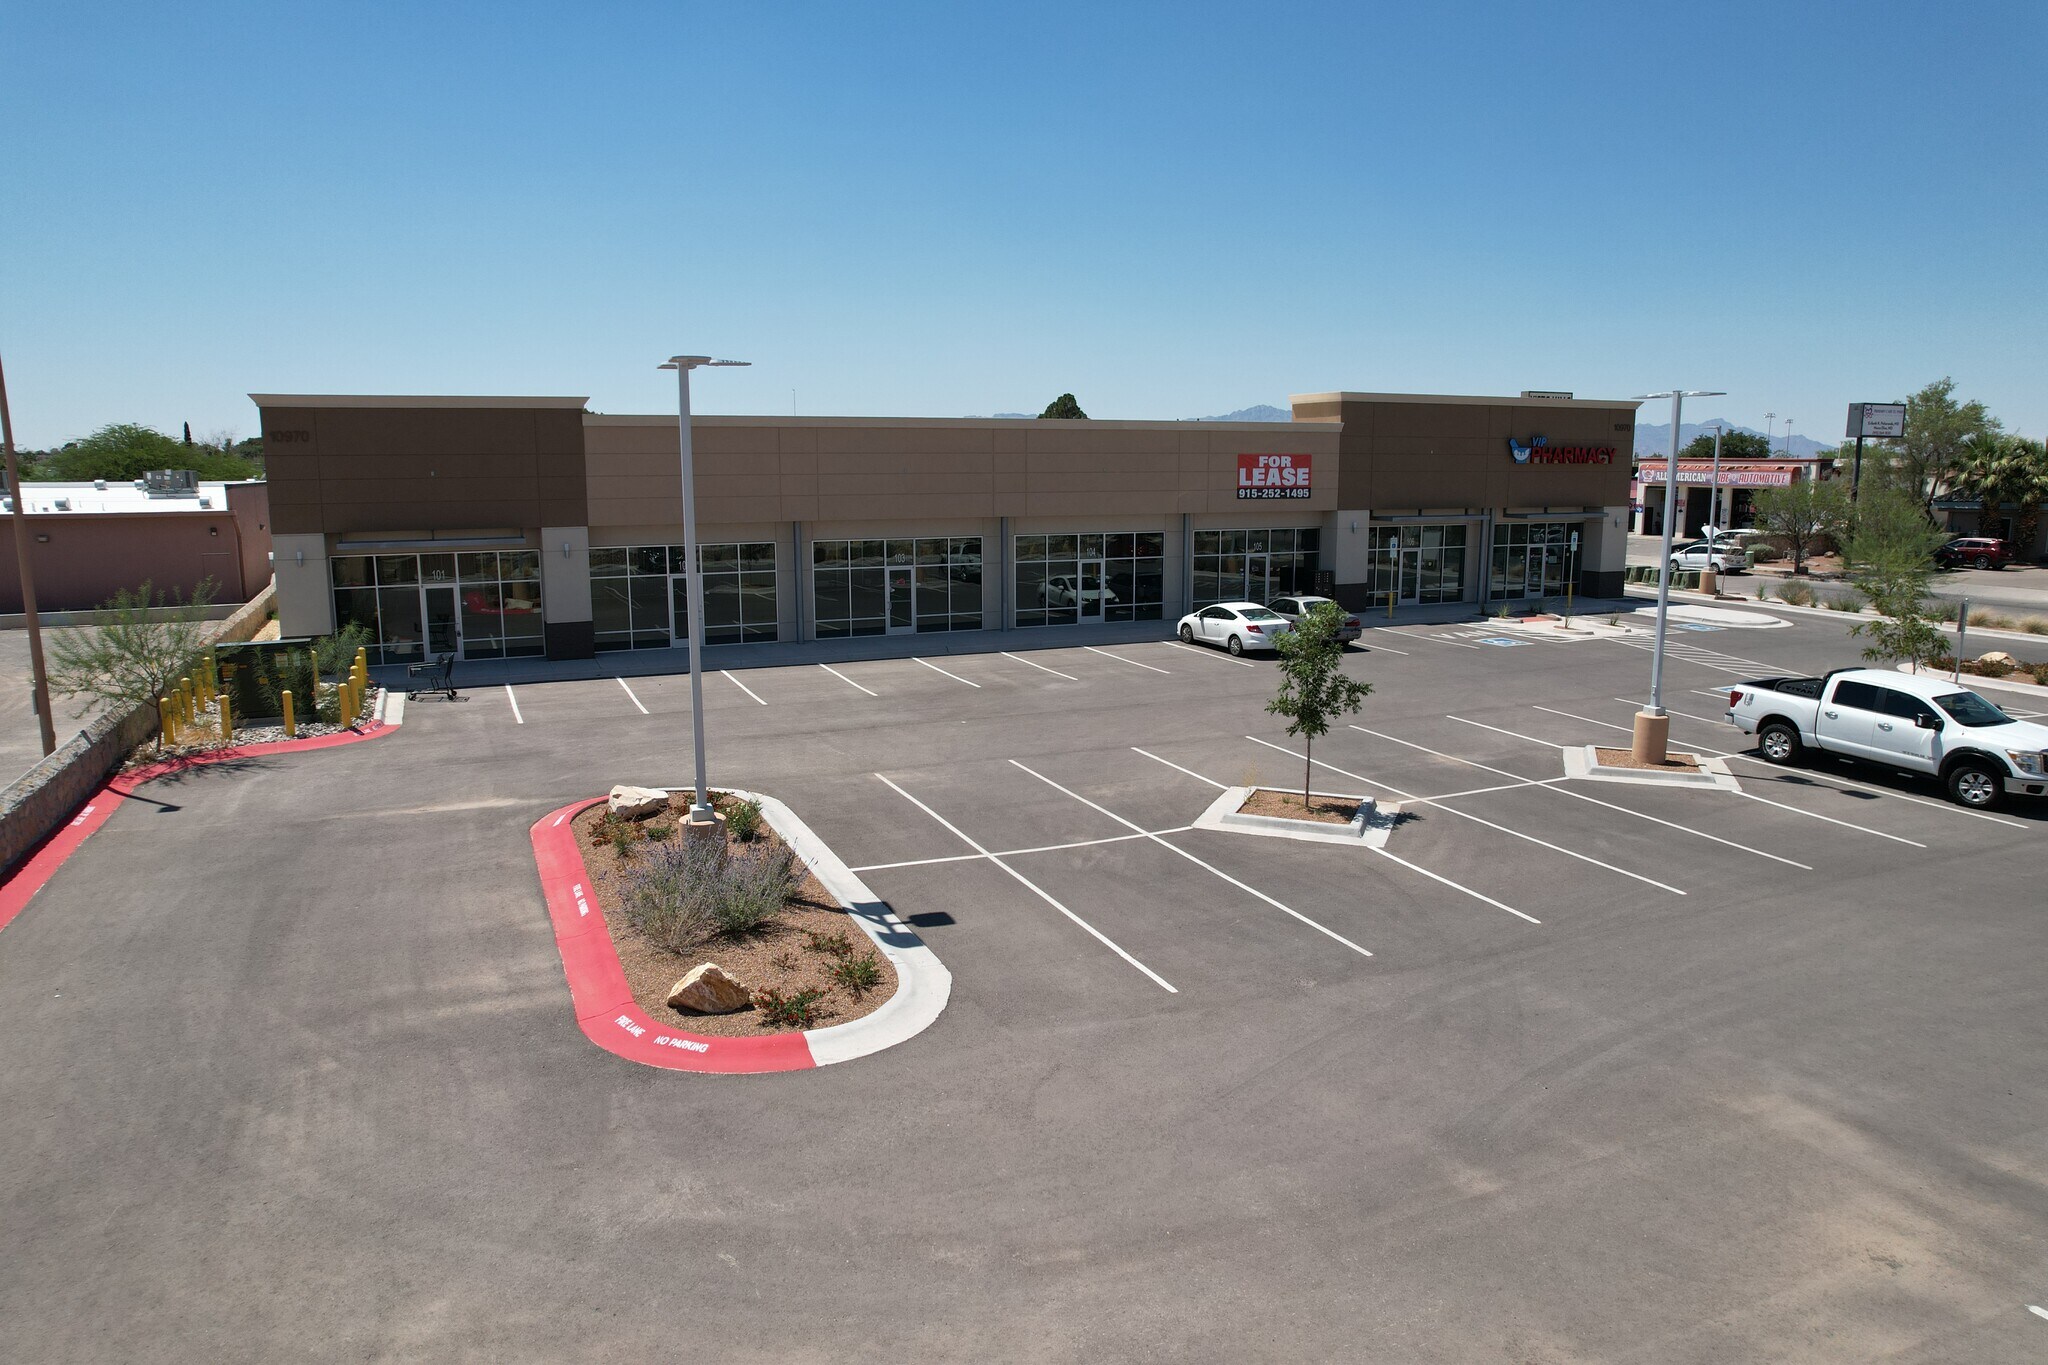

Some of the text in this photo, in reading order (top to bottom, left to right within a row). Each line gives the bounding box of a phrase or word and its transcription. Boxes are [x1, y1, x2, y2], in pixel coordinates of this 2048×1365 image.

[1258, 455, 1292, 468] FOR
[1530, 447, 1617, 464] PHARMACY
[1239, 467, 1310, 486] LEASE
[1675, 472, 1707, 482] MERICAN
[1737, 473, 1787, 484] AUTOMOTIVE
[1238, 488, 1309, 498] 915-252-1495
[895, 553, 905, 563] 103
[678, 560, 686, 571] 10
[431, 569, 445, 580] 101
[614, 1014, 646, 1038] FIRE LANE
[653, 1035, 709, 1053] NO PARKING
